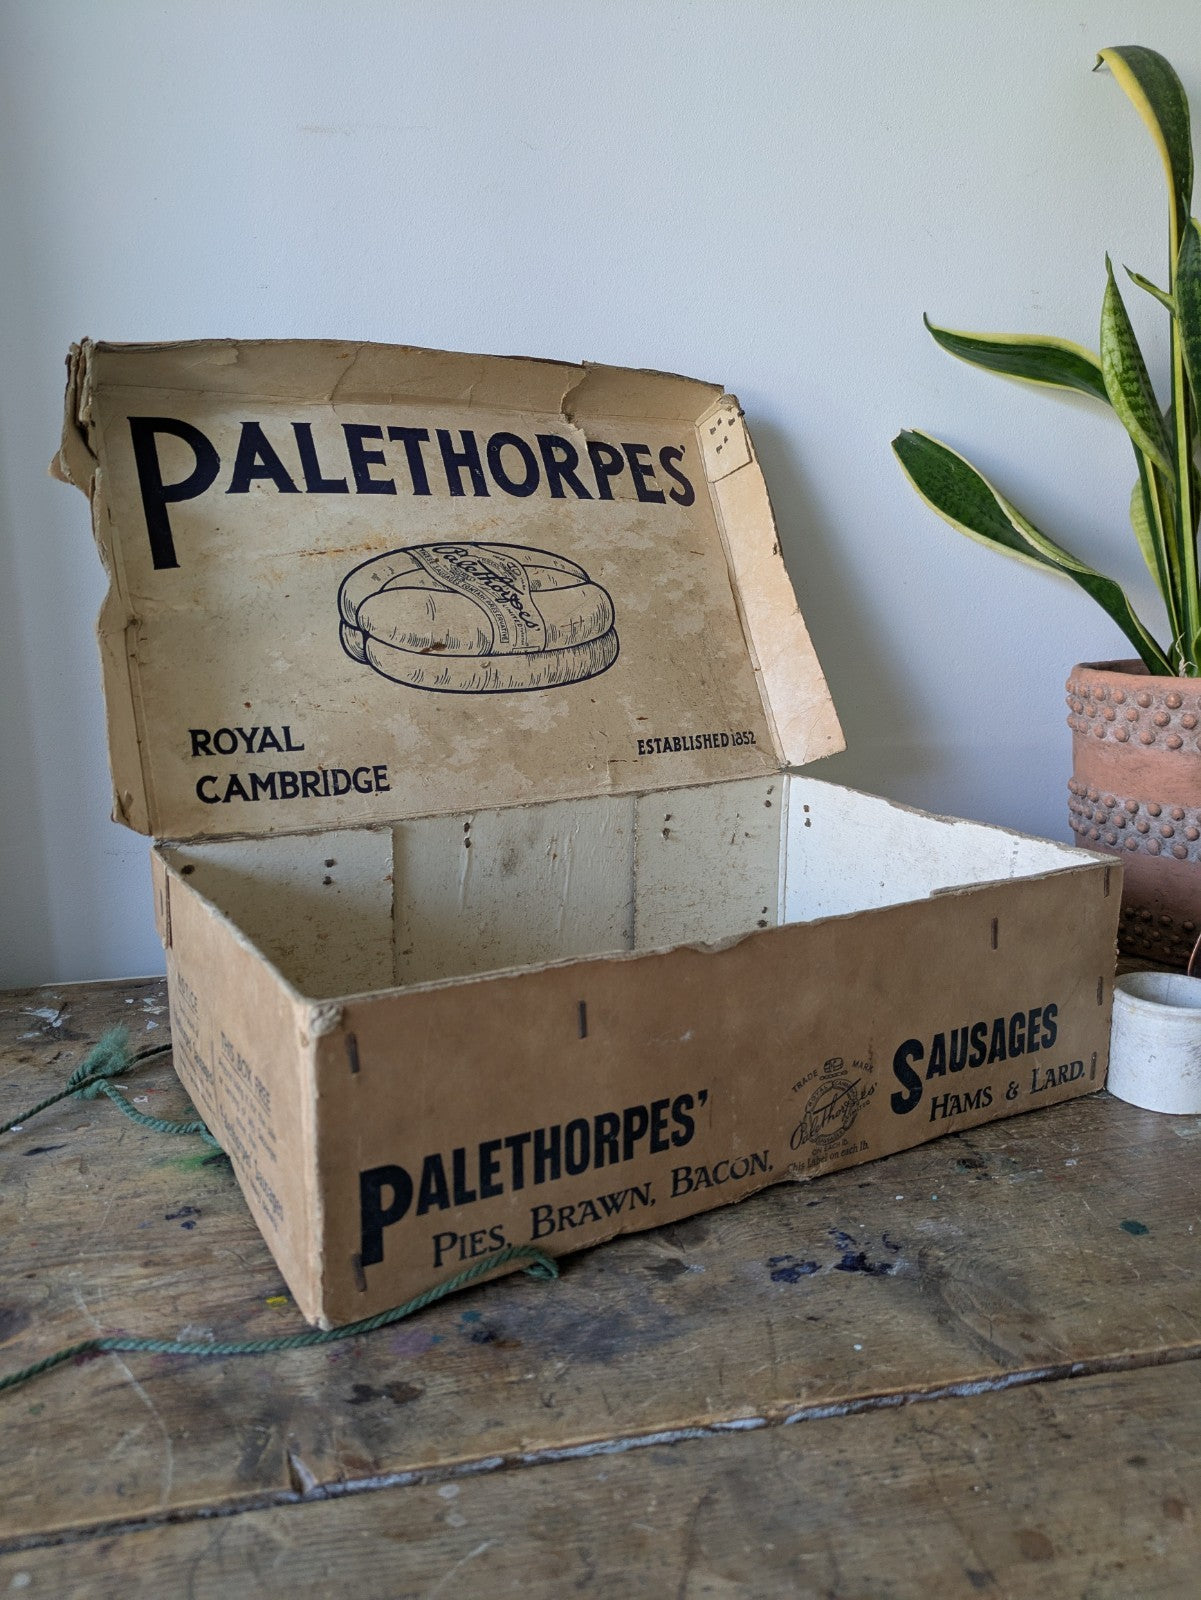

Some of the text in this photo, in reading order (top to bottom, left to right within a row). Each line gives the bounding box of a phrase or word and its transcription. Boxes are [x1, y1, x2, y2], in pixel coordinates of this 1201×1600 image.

[126, 416, 694, 570] PALETHORPES'
[188, 726, 305, 757] ROYAL
[637, 731, 756, 755] ESTABLISHED 1852
[196, 765, 391, 804] CAMBRIDGE
[792, 1069, 819, 1093] TRADE
[890, 1003, 1059, 1115] SAUSAGES
[929, 1060, 1086, 1123] HAMS & LARD.
[358, 1089, 709, 1267] PALETHORPES'
[432, 1150, 774, 1268] PIES, BRAWN, BACON,
